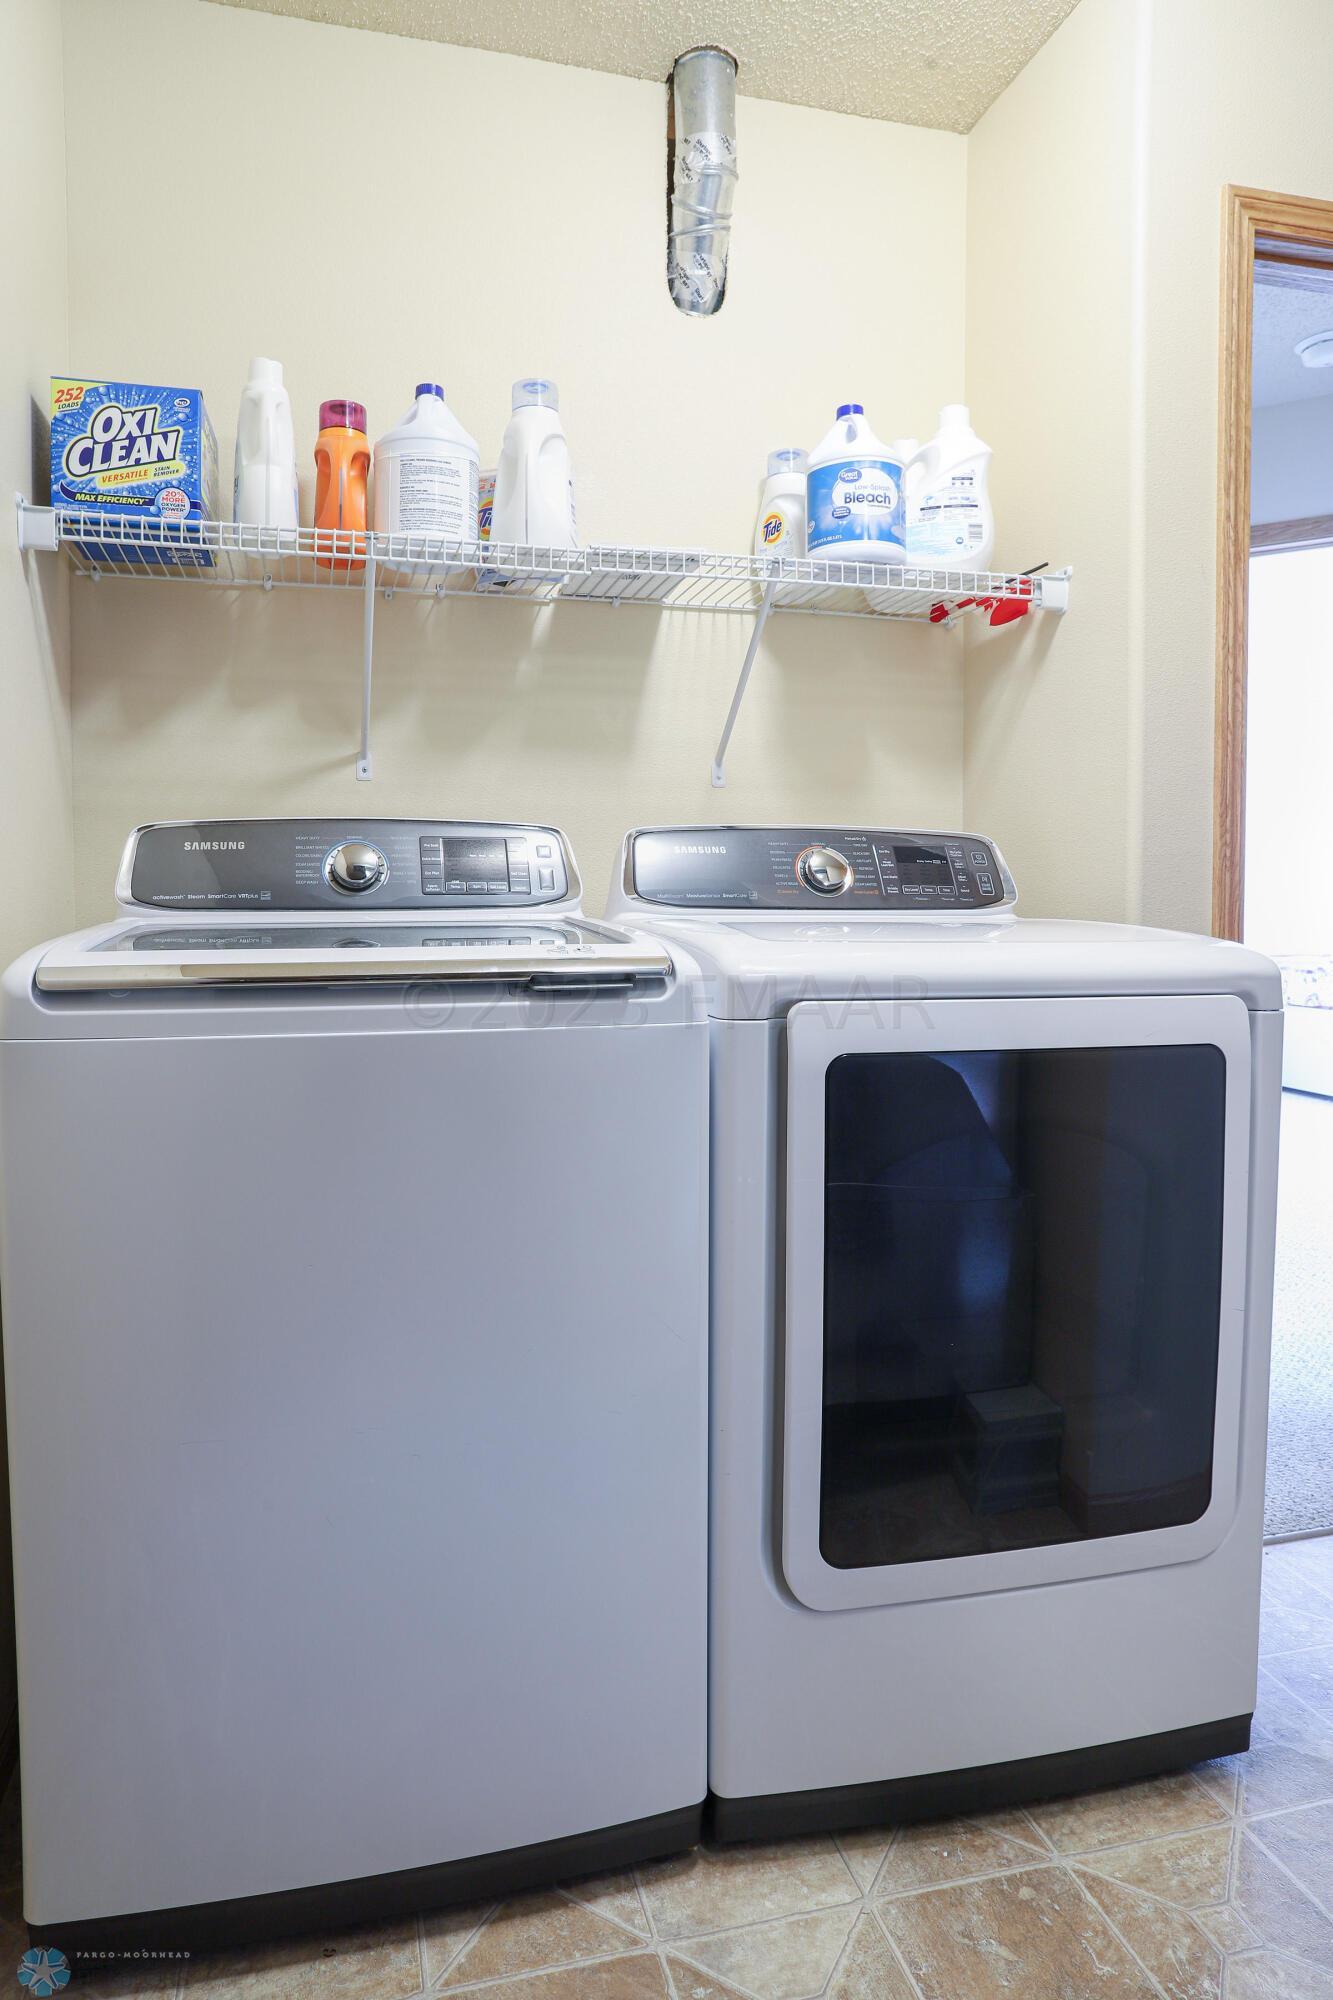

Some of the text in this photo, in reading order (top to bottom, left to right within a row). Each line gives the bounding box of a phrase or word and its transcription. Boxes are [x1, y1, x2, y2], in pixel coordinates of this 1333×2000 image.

[55, 387, 84, 404] 252
[58, 401, 79, 410] LOADS
[93, 406, 157, 441] OXI
[68, 431, 178, 475] CLEAN
[102, 469, 149, 483] VERSATILE
[153, 469, 180, 477] REMOVER
[75, 493, 97, 502] MAX
[165, 490, 185, 498] 20%
[844, 492, 891, 505] Bleach
[763, 519, 783, 543] Tide
[184, 841, 245, 851] SAMSUNG
[675, 844, 727, 854] SAMSUNG
